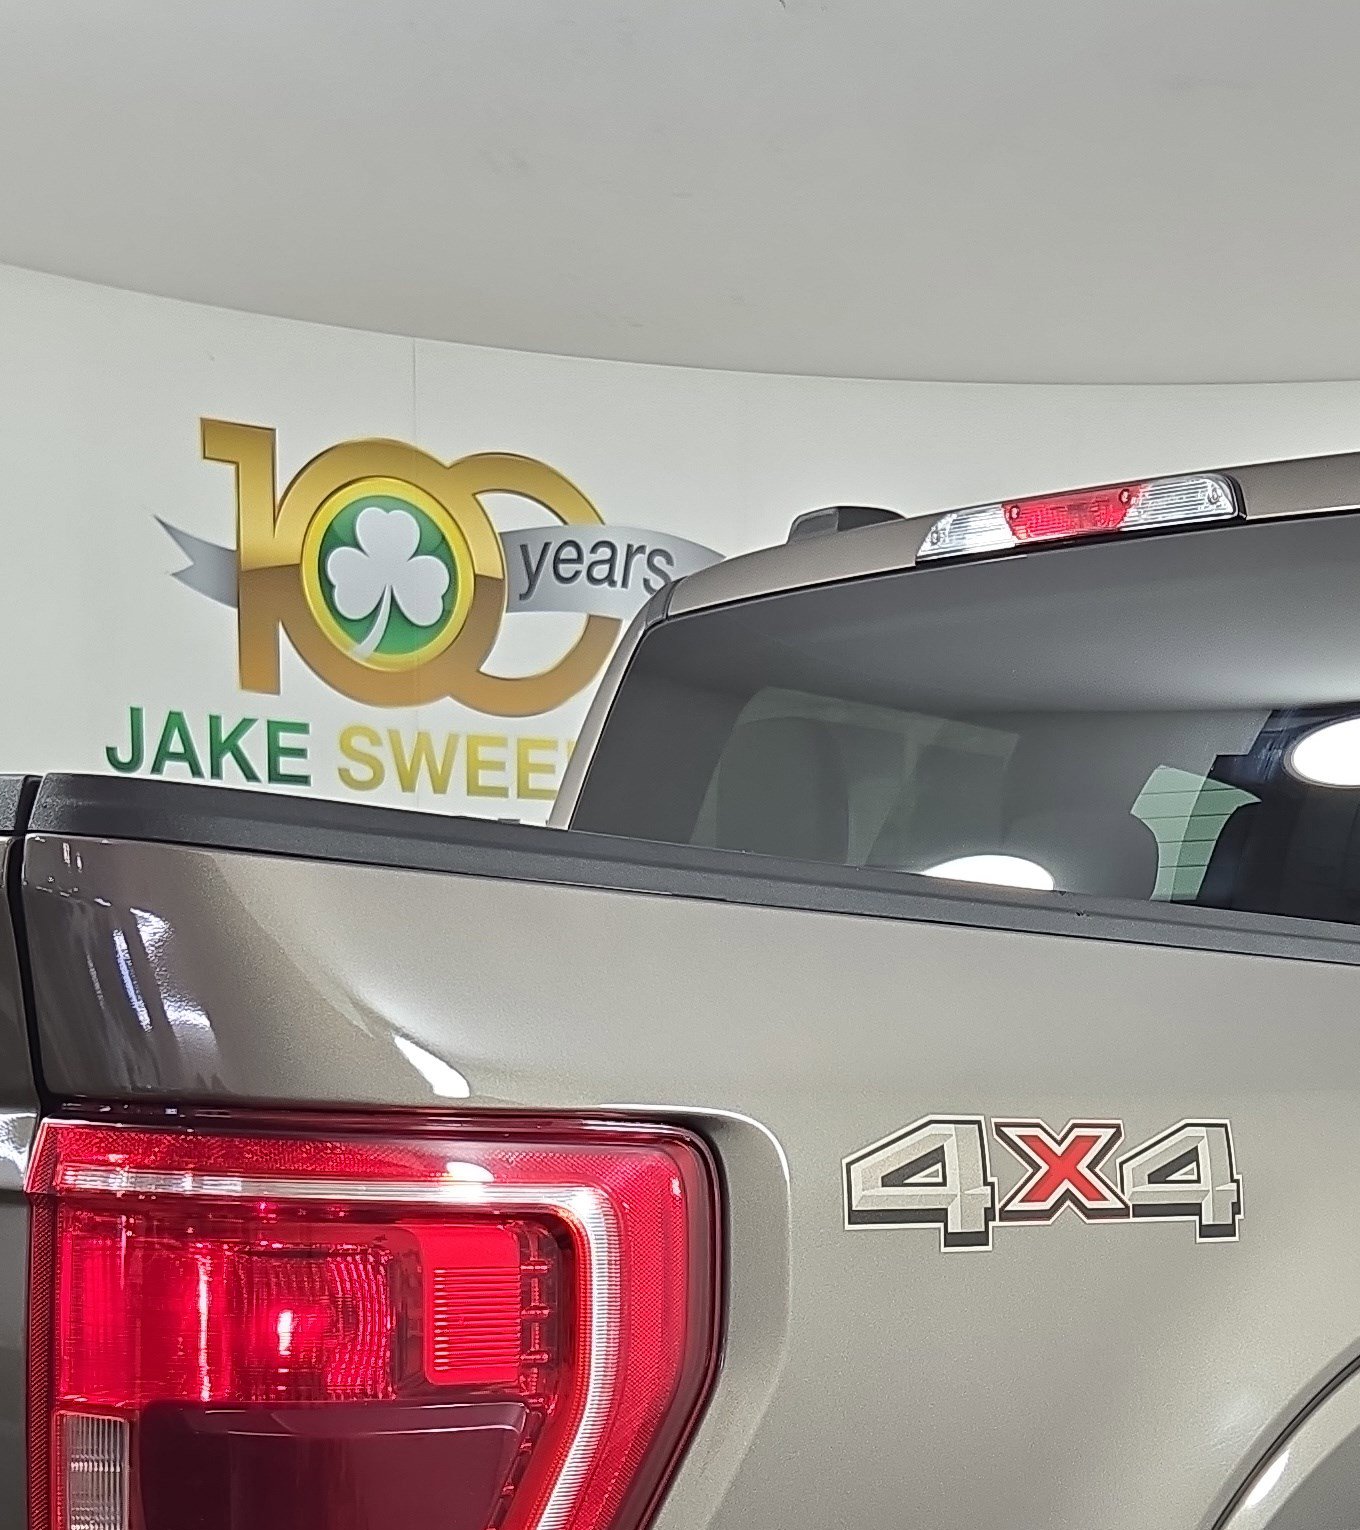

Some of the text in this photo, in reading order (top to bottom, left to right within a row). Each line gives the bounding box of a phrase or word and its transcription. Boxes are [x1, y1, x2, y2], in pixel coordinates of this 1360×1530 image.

[519, 538, 677, 600] years
[106, 706, 572, 802] JAKE SWEE
